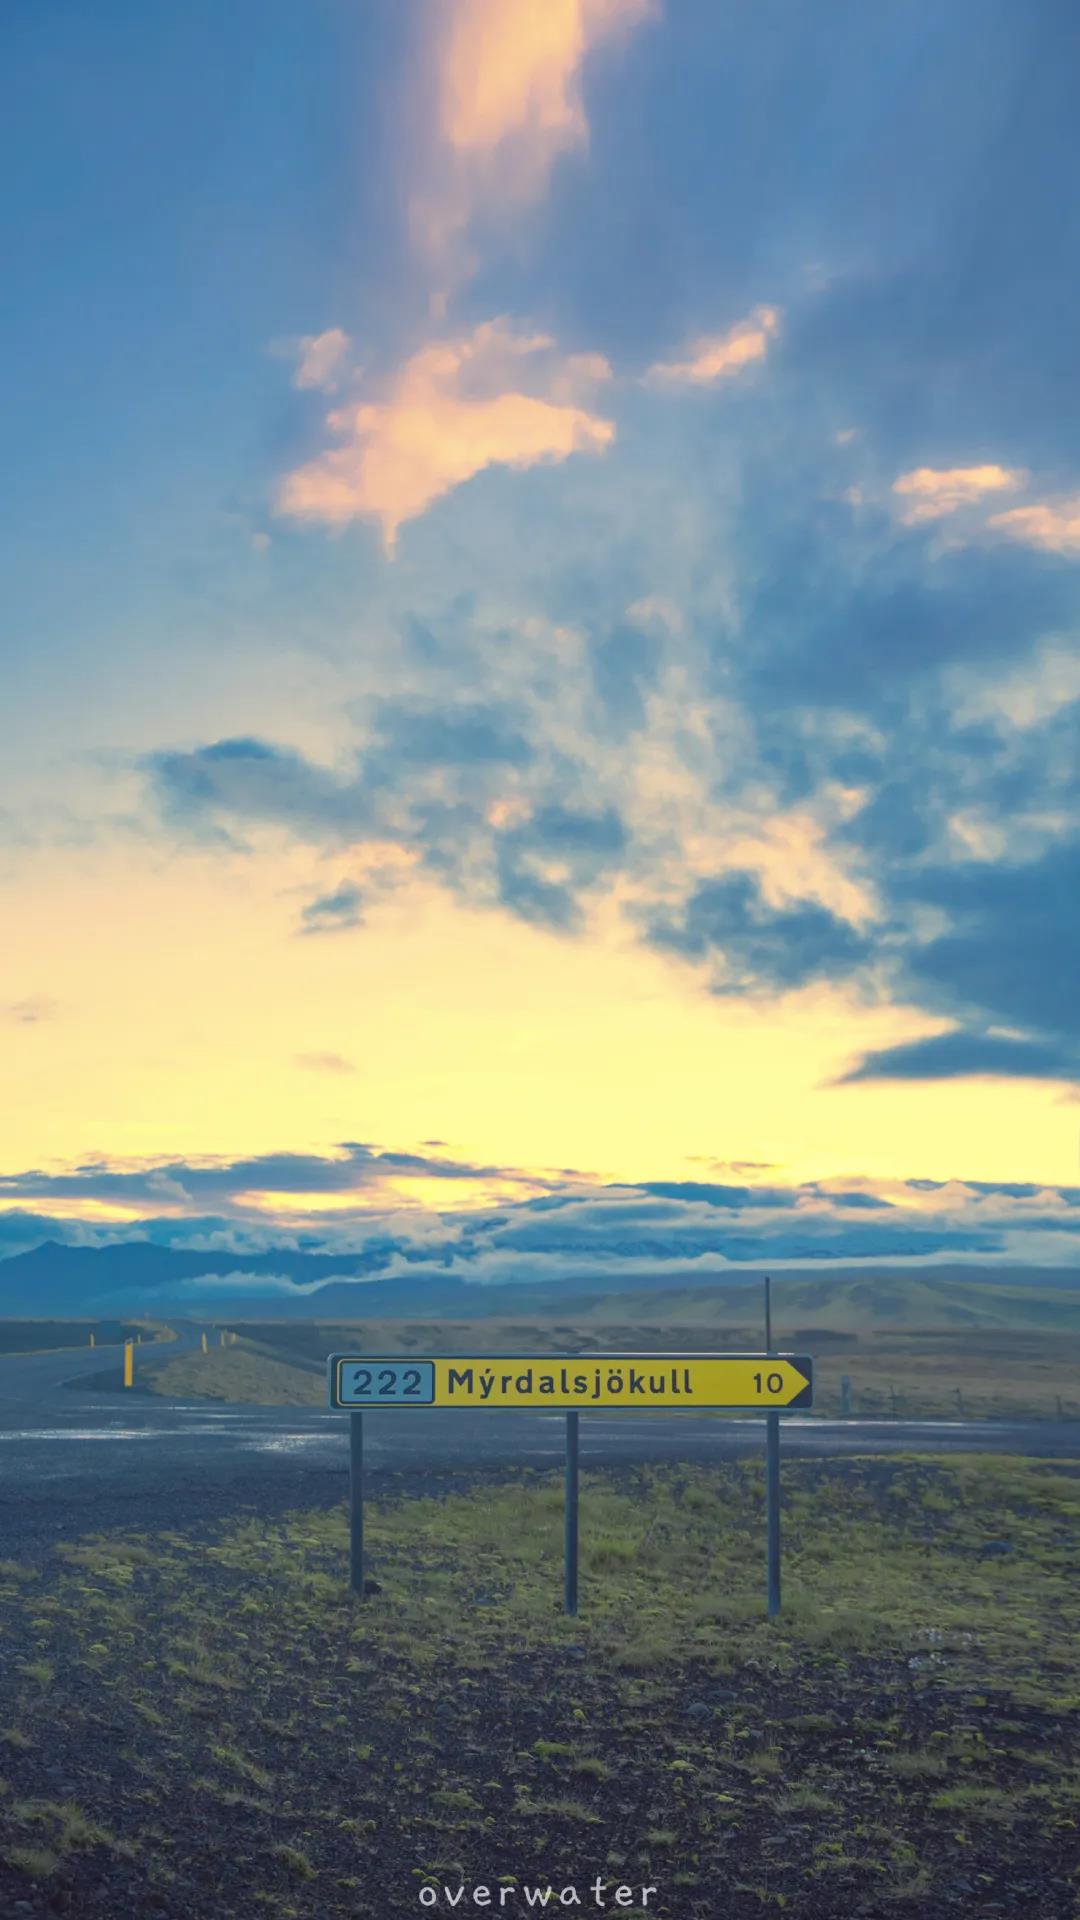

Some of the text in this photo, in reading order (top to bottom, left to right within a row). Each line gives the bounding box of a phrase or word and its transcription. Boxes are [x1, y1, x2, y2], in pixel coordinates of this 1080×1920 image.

[352, 1368, 784, 1400] 222 Mýrdalsjökull 10
